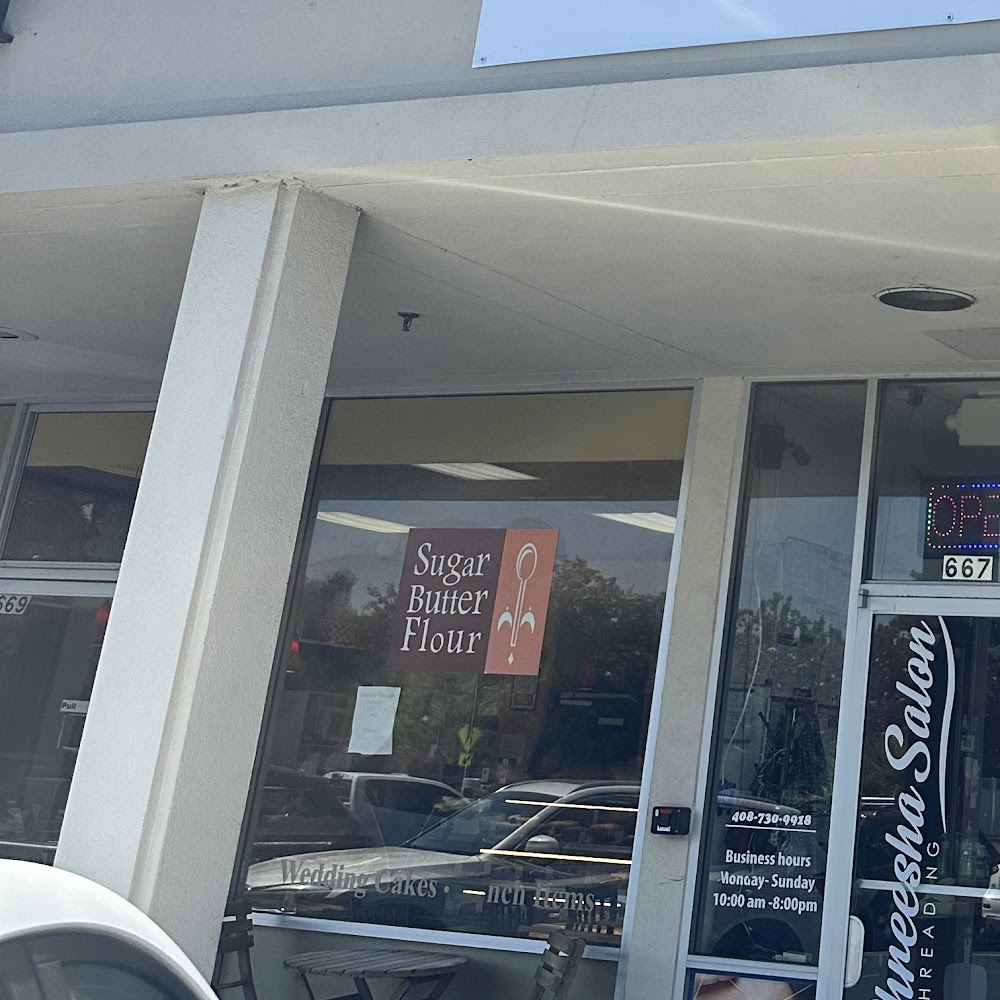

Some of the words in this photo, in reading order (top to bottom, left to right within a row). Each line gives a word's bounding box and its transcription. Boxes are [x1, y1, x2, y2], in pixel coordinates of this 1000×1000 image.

[413, 542, 491, 586] Sugar
[945, 557, 991, 578] 667
[406, 584, 489, 615] Butter
[400, 616, 482, 654] Flour
[62, 702, 77, 710] Pull
[885, 620, 936, 783] Salon
[725, 849, 776, 866] Business
[777, 852, 812, 867] hours
[281, 859, 368, 899] Wedding
[374, 868, 439, 899] Cakes
[771, 874, 816, 893] Sunday
[871, 785, 926, 1000] hreesha
[713, 892, 745, 907] 10:00
[746, 897, 766, 909] am
